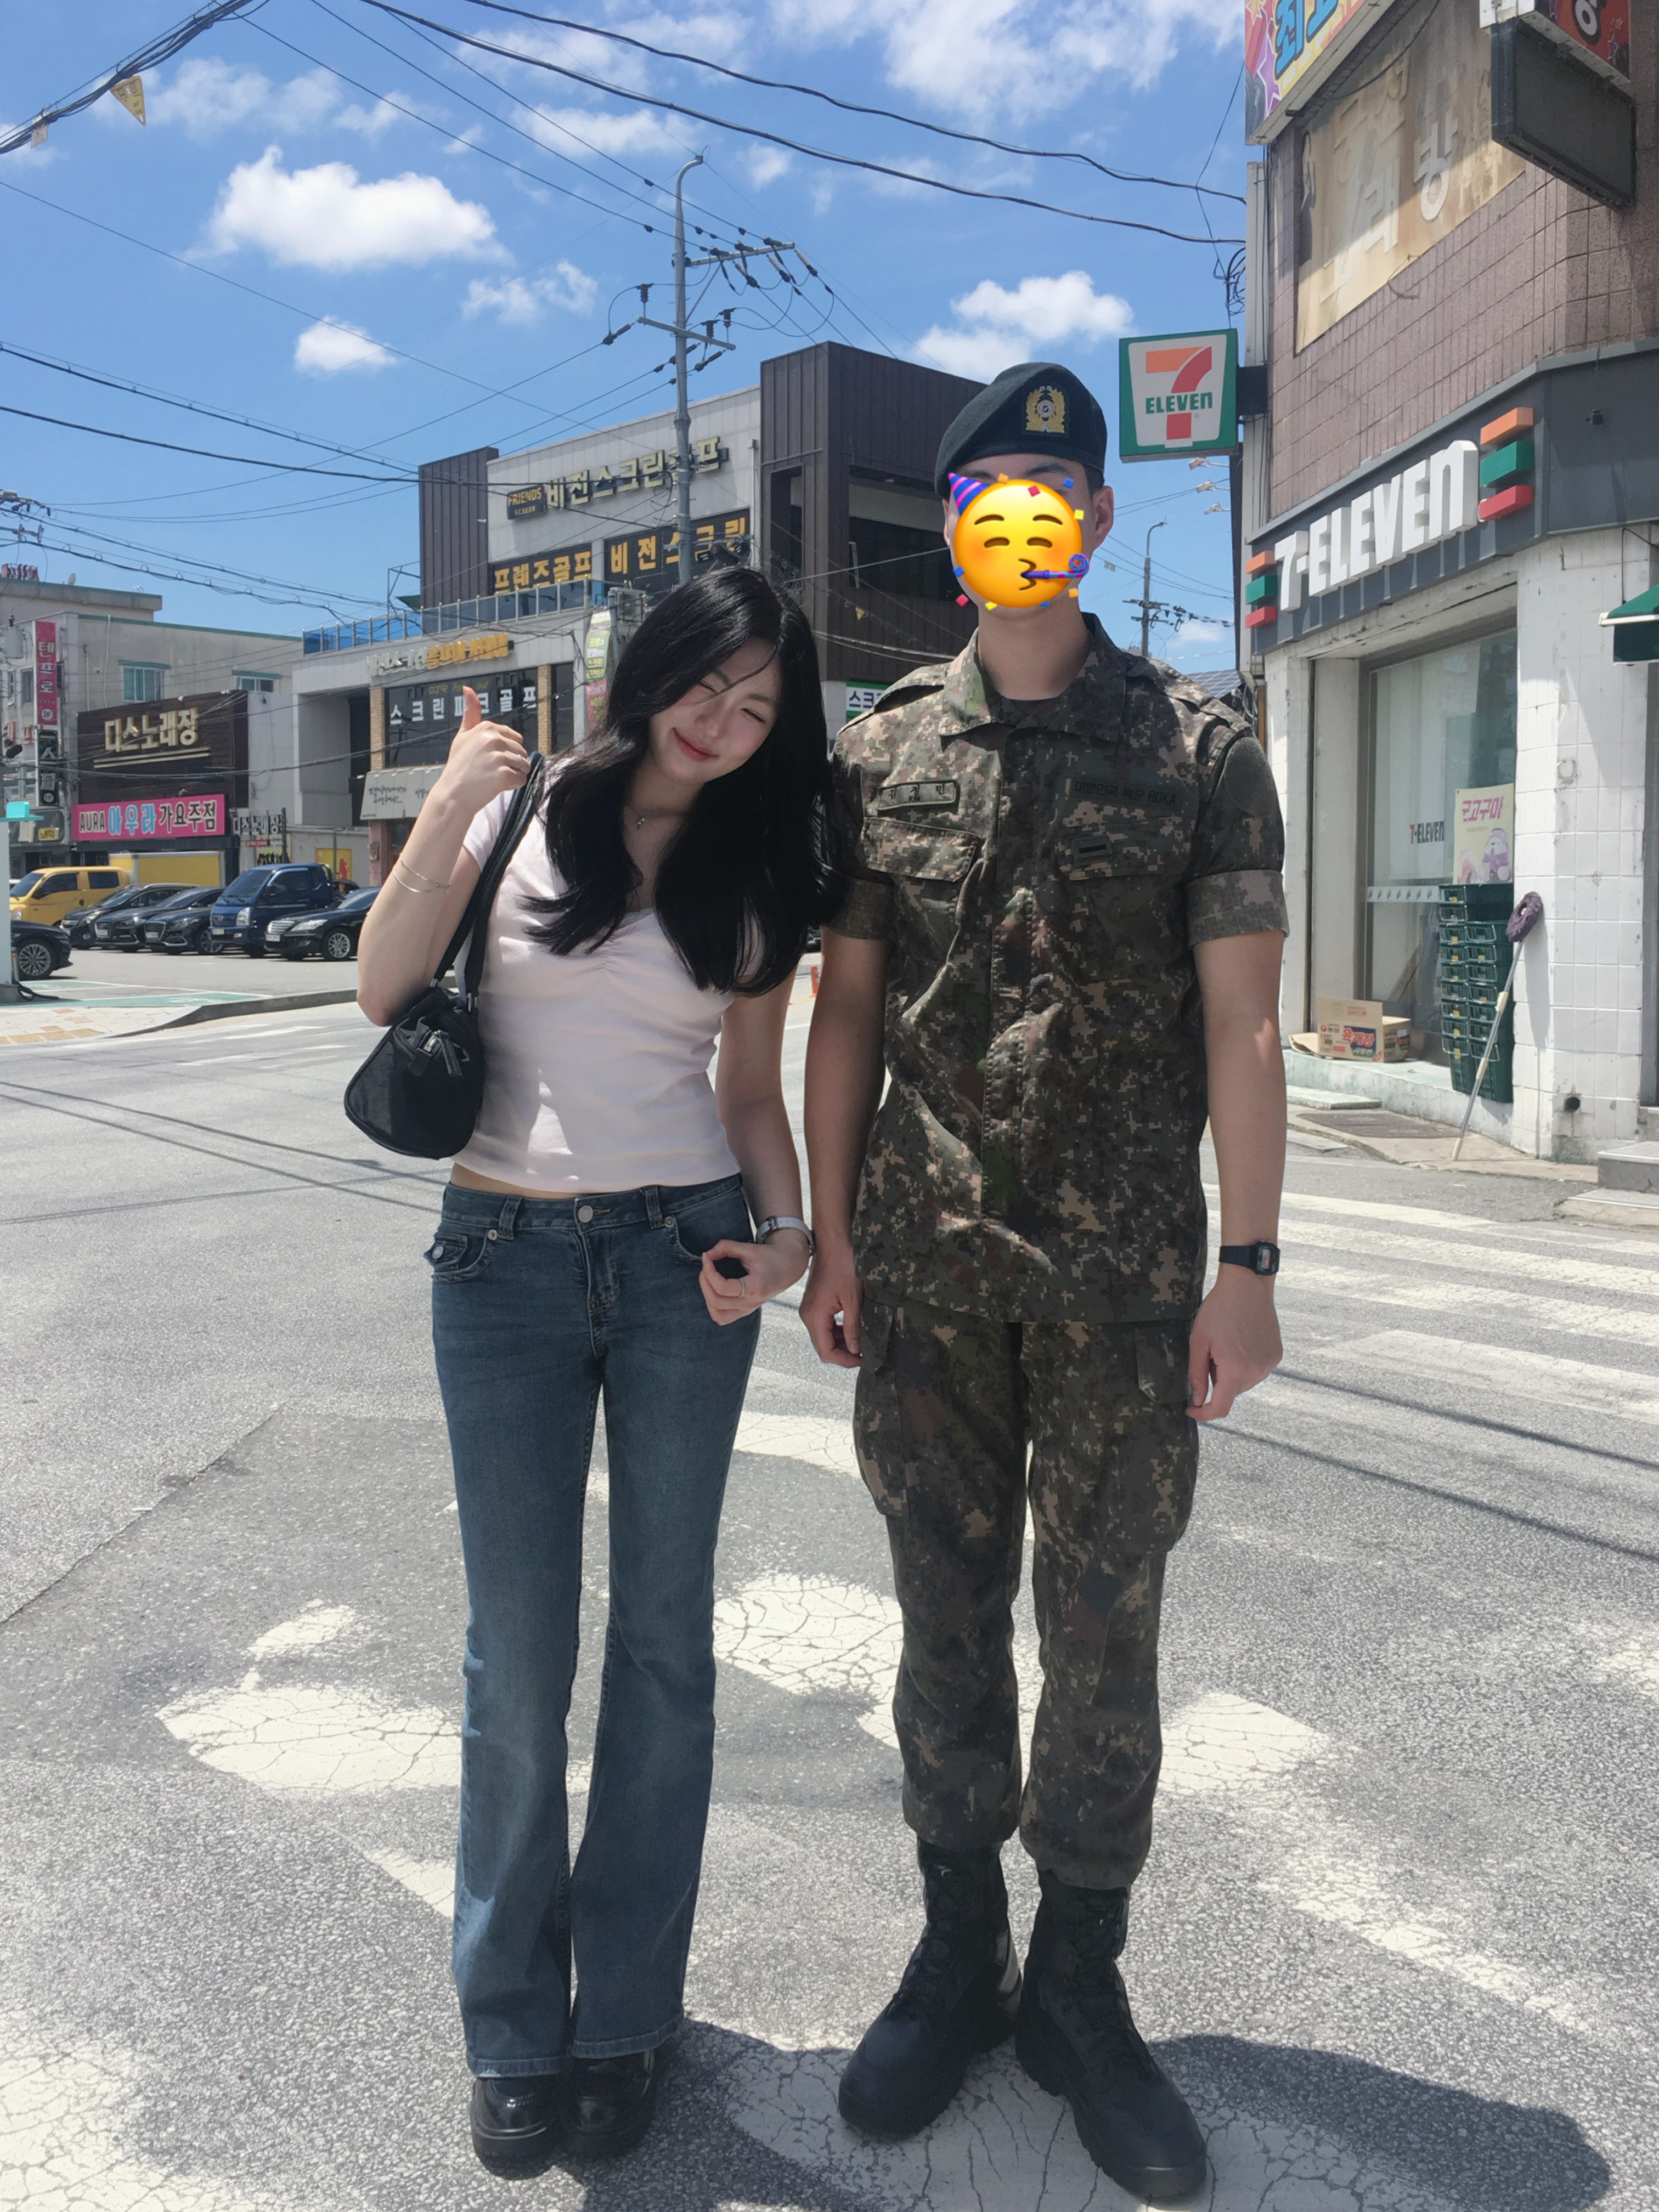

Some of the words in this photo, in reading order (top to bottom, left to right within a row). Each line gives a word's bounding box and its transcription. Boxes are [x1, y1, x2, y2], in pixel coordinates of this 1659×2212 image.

[1146, 345, 1212, 440] 7
[507, 487, 542, 507] FRIENDS
[514, 505, 536, 517] SCREEN
[494, 550, 592, 596] 프렌즈골프
[38, 641, 55, 694] 텐프로
[849, 691, 882, 709] 스크
[42, 710, 52, 719] 2F
[1147, 790, 1176, 806] ROKA
[79, 811, 106, 833] AURA
[108, 804, 156, 836] 아우라
[159, 800, 217, 834] 가요주점
[1342, 1027, 1375, 1048] 육개장
